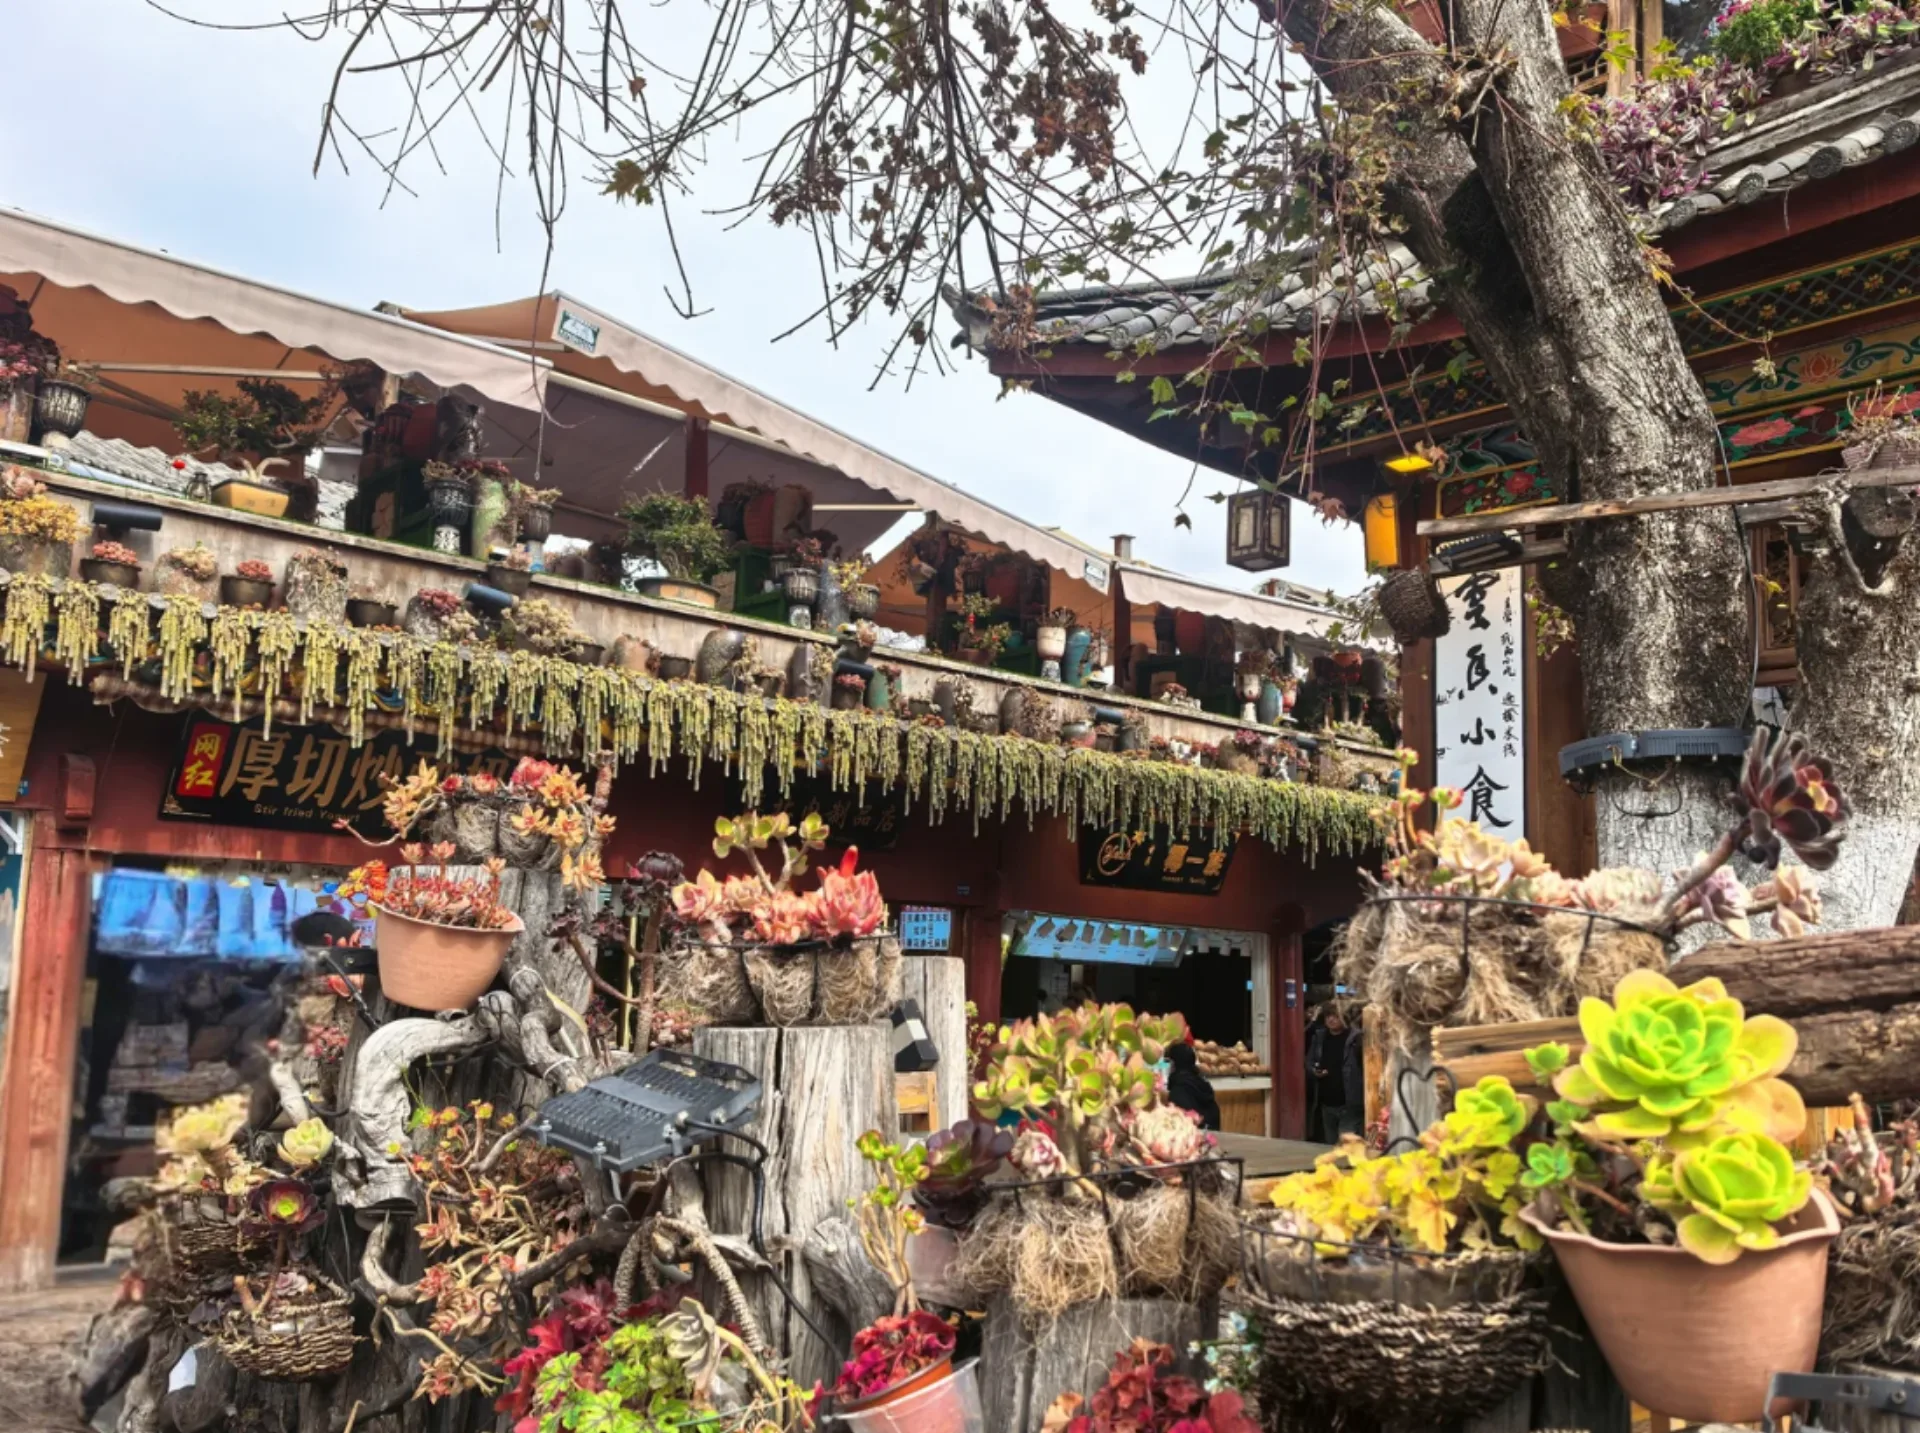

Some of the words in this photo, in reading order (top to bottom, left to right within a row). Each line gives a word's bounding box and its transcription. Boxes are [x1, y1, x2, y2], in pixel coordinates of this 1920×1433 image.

[184, 733, 221, 790] 网红
[253, 803, 278, 815] Stir
[282, 806, 313, 819] fried
